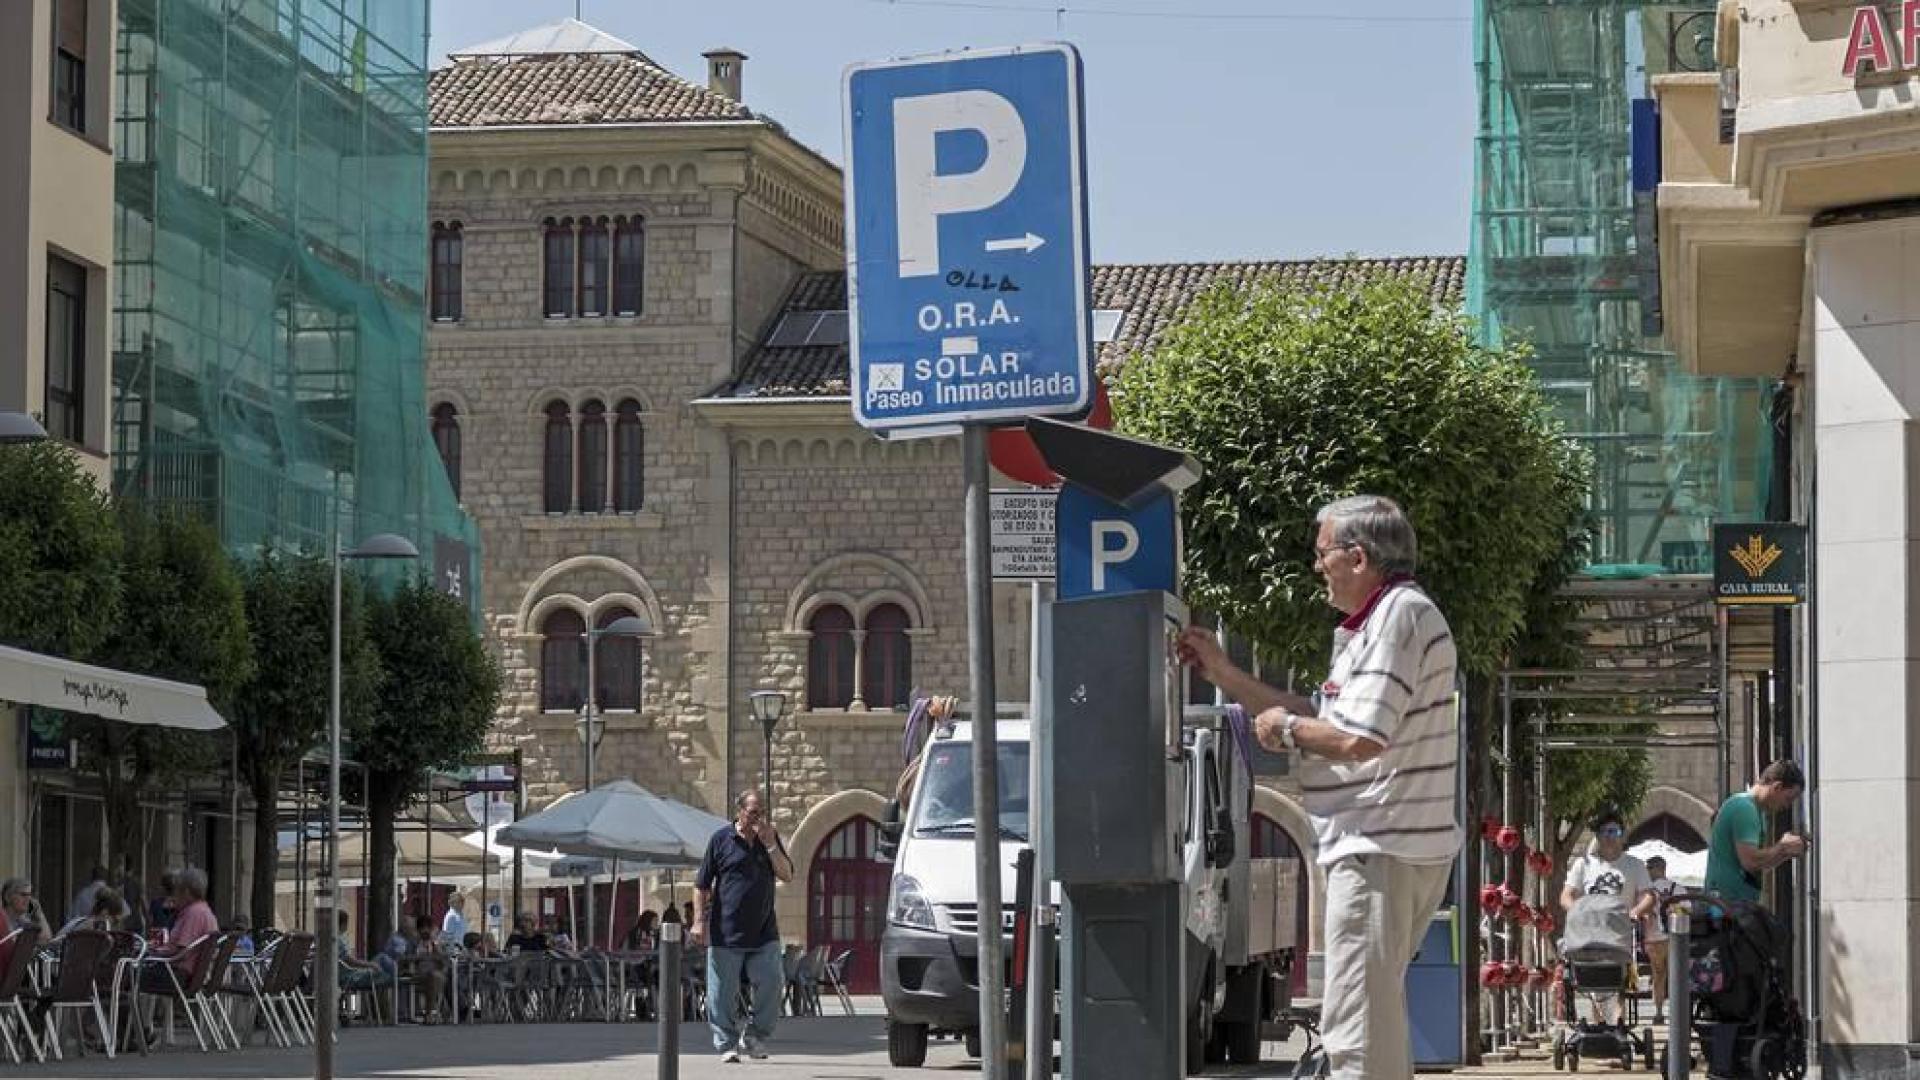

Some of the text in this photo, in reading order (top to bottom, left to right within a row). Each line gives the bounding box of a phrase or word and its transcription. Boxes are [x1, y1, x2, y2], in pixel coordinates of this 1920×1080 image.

[893, 89, 1027, 278] P
[918, 299, 1021, 331] O.R.A.
[915, 352, 1019, 380] SOLAR
[866, 372, 1075, 410] Paseo Inmaculada
[1091, 520, 1139, 591] P
[1719, 583, 1792, 594] CAJA RURAL
